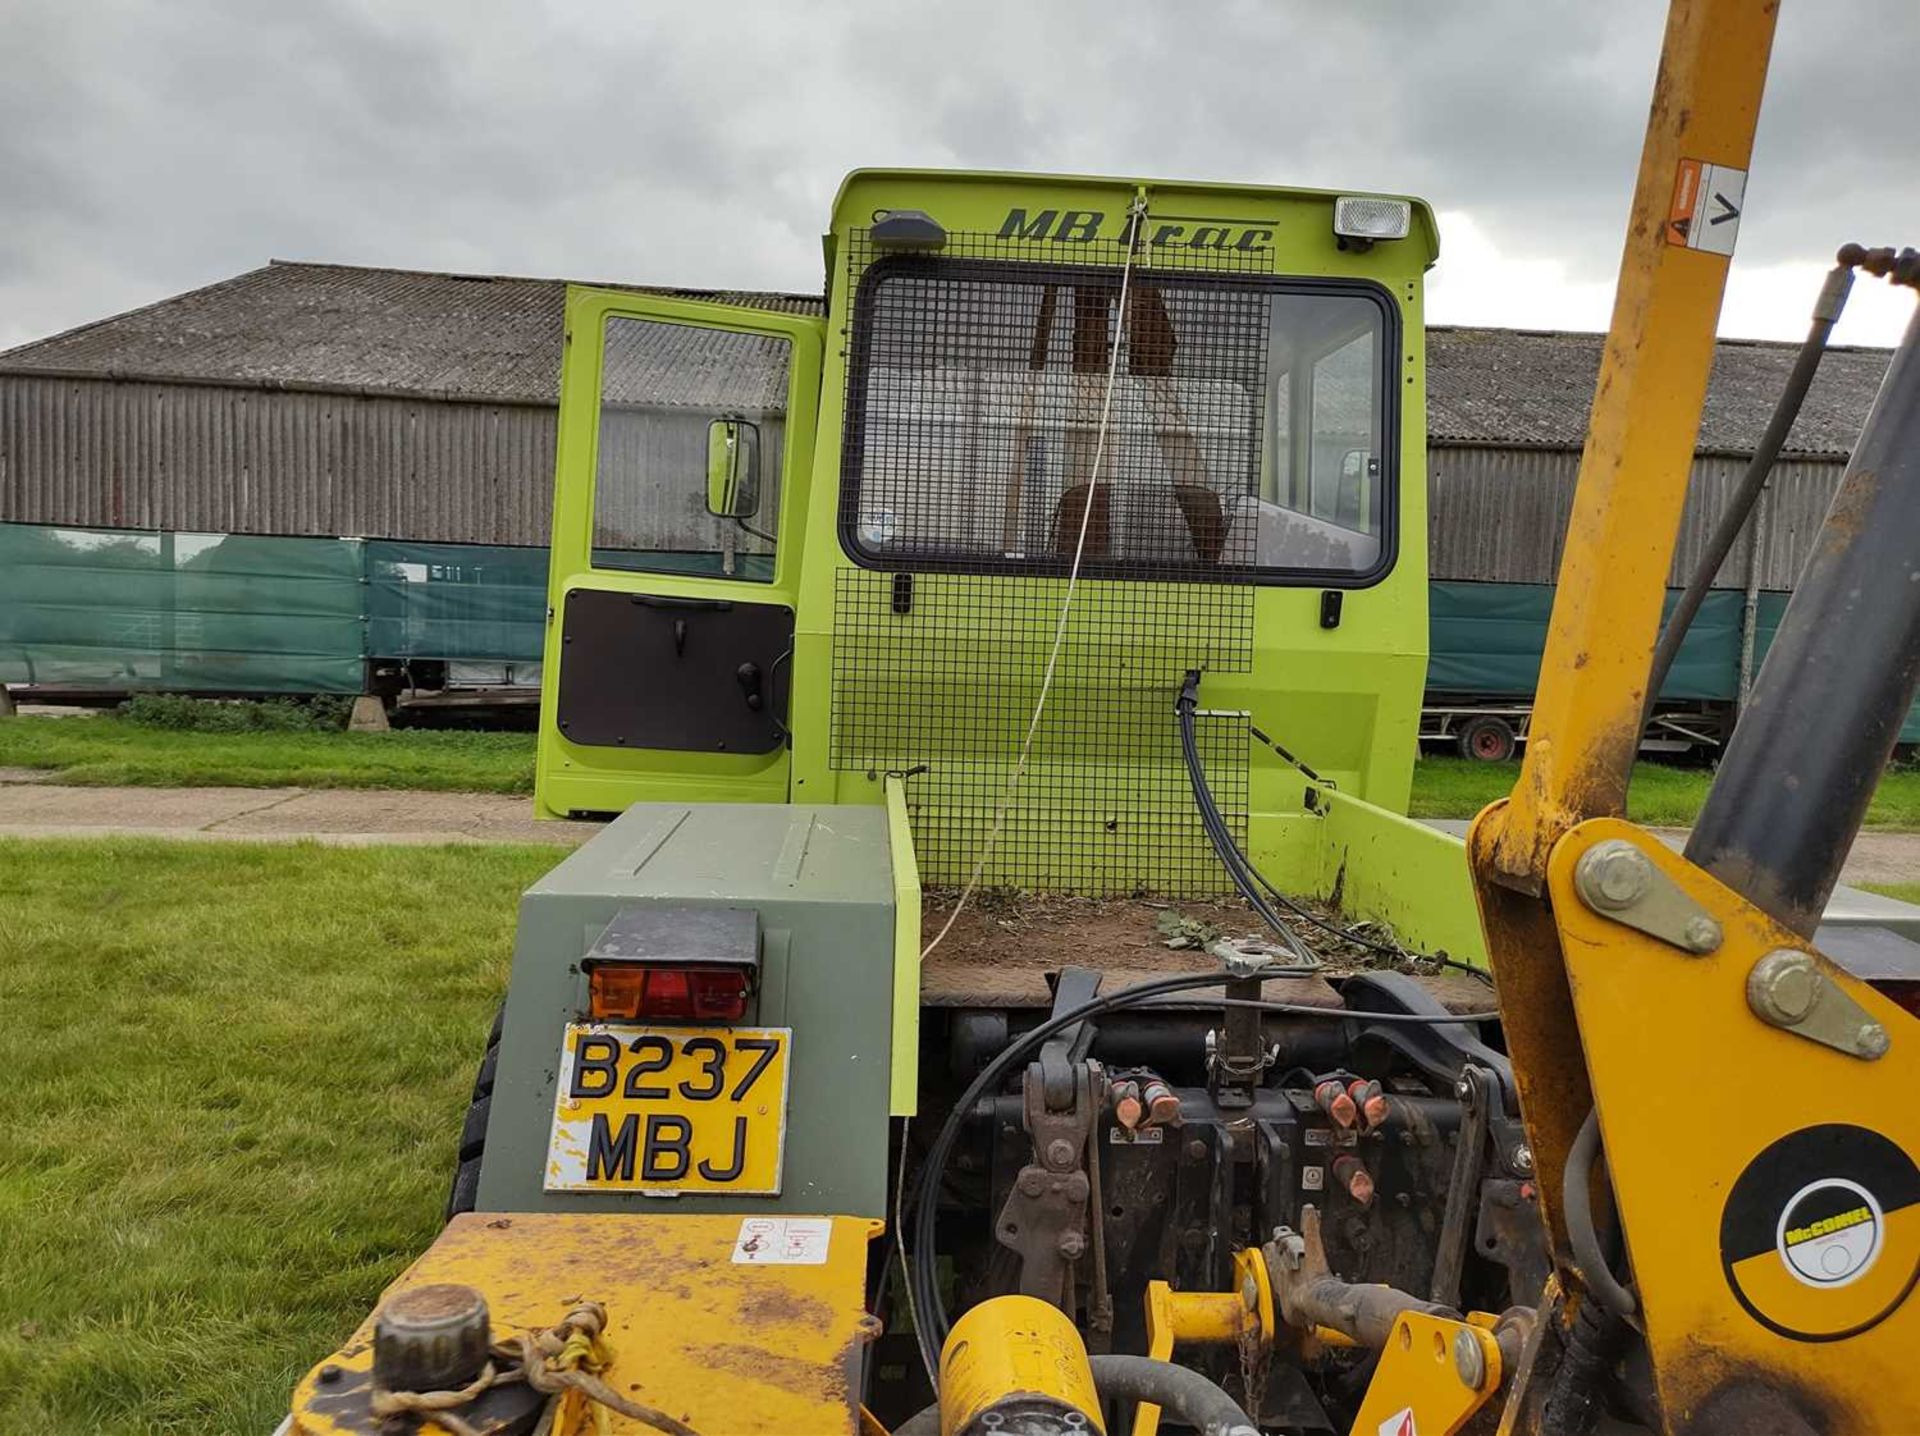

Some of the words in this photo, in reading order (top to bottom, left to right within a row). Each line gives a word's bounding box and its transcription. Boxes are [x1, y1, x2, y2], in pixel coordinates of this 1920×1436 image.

[997, 209, 1104, 242] MB
[1118, 214, 1278, 253] trac
[570, 1034, 780, 1101] B237
[586, 1113, 748, 1182] MBJ
